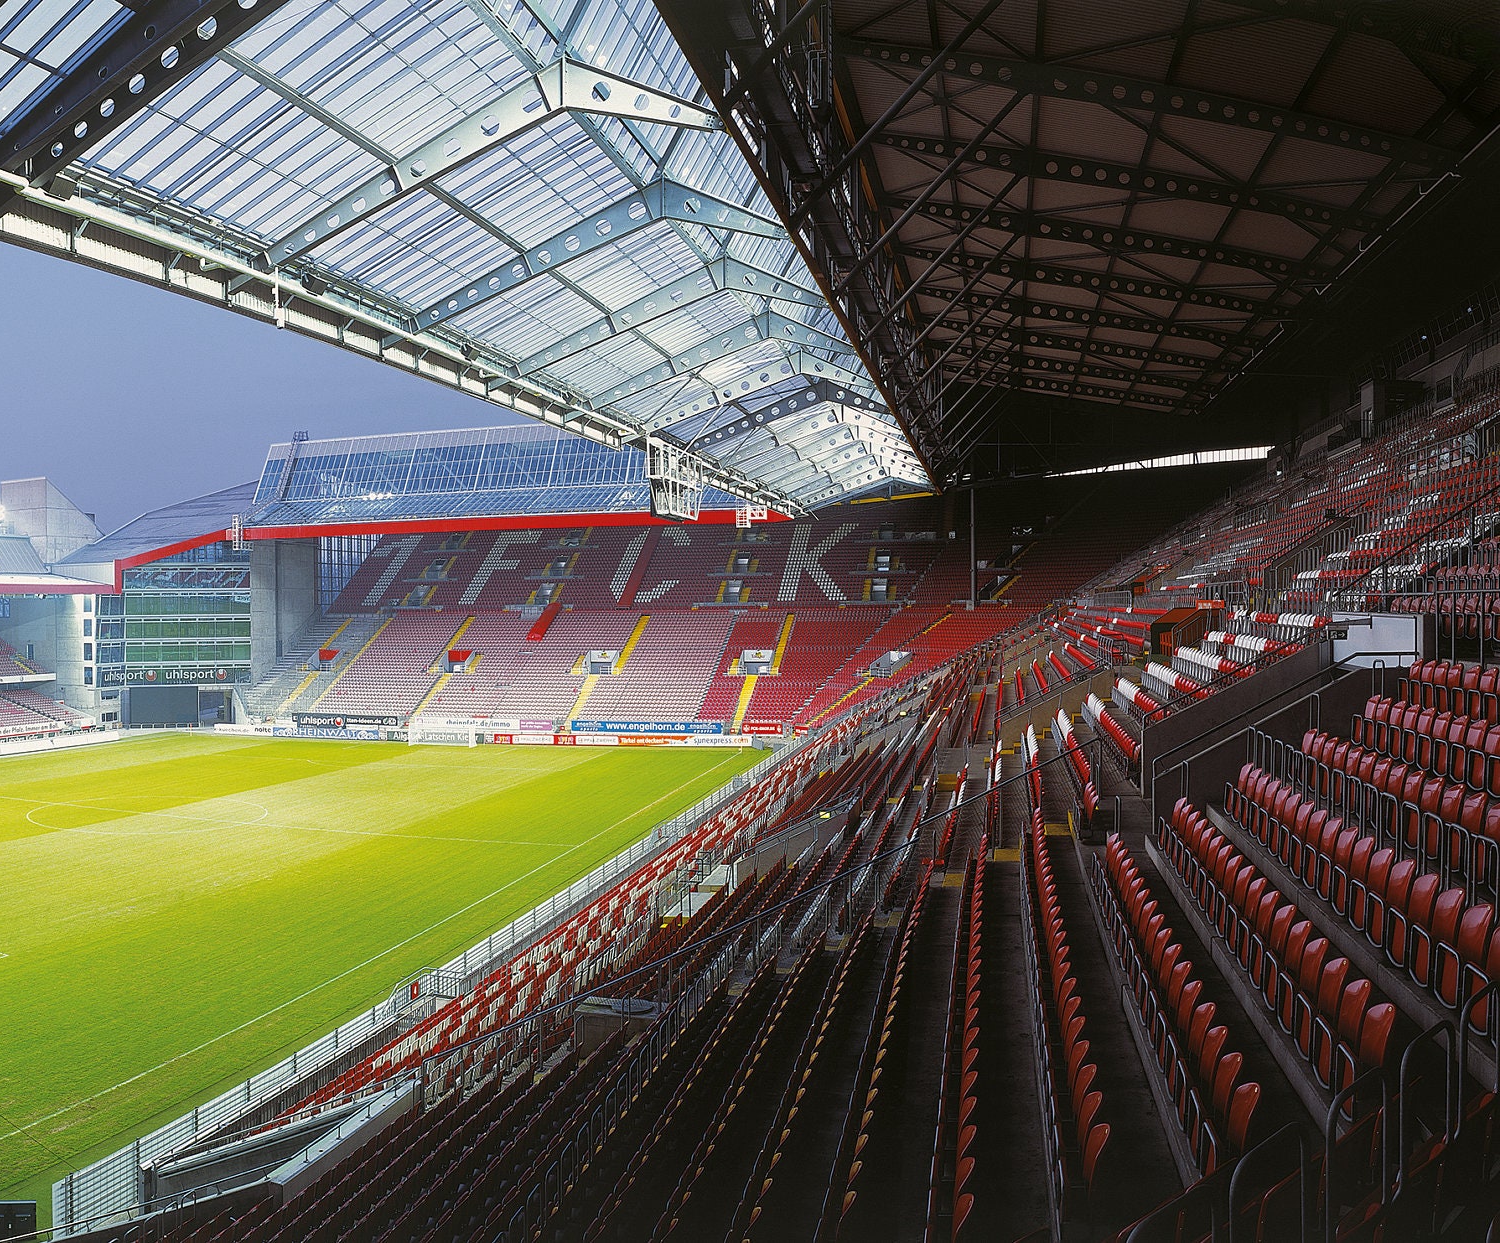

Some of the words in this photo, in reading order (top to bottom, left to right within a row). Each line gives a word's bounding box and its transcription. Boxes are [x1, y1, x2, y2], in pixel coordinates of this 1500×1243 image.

[104, 671, 144, 682] uhlsport
[165, 669, 214, 681] uhlsport
[300, 716, 335, 726] uhlsport
[606, 722, 686, 732] www.engelhorn.de
[693, 736, 749, 746] sunexpress.com
